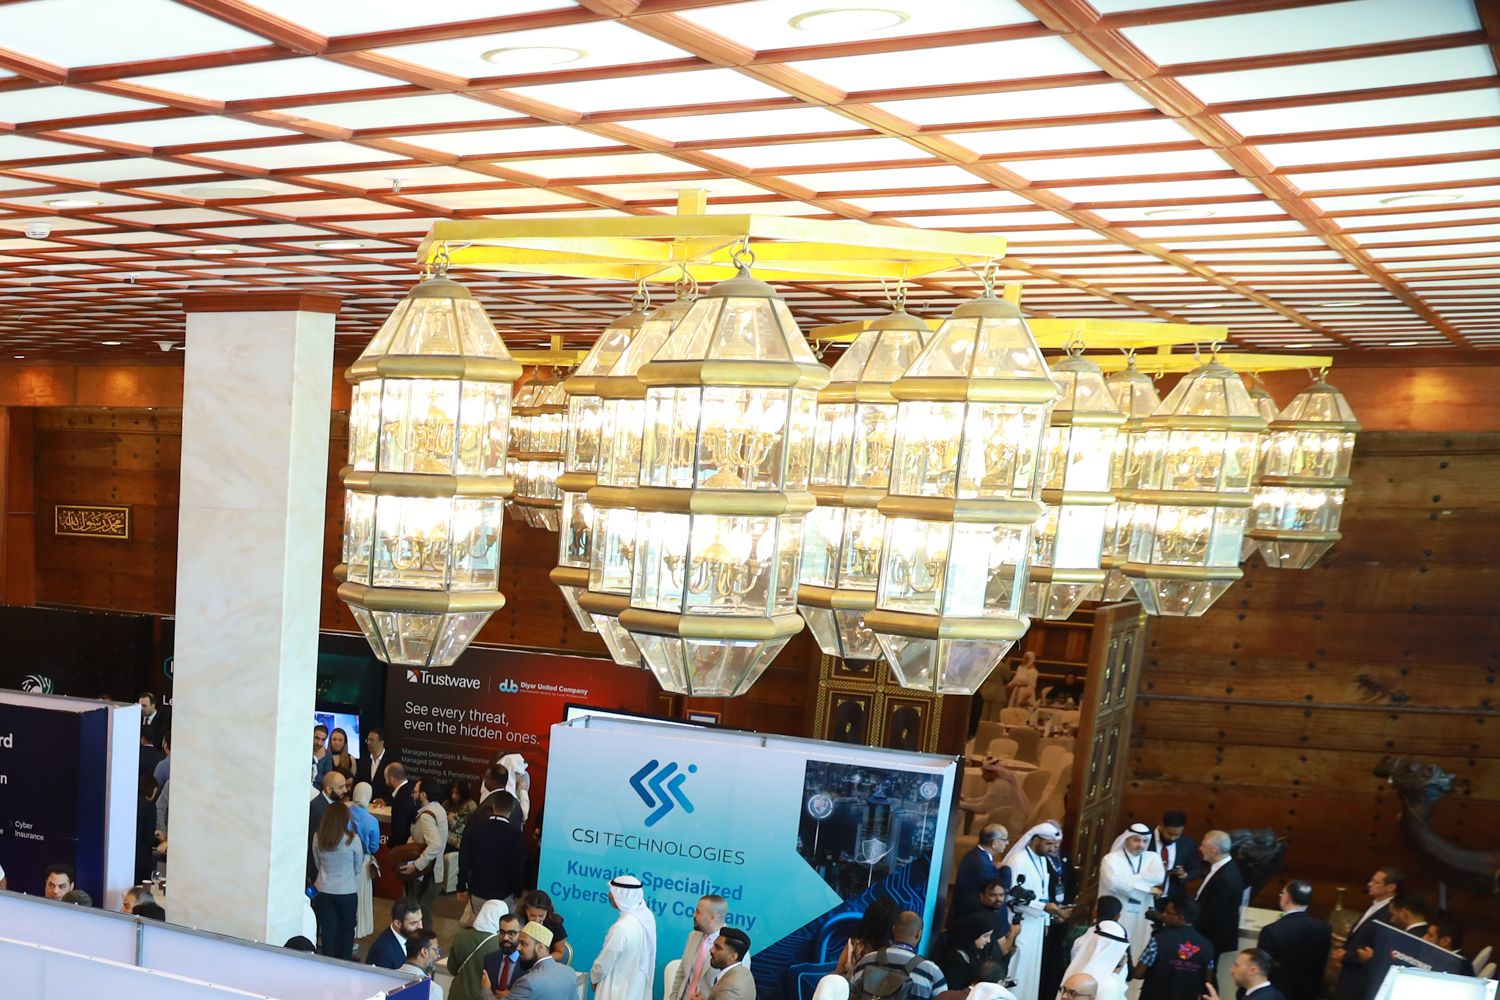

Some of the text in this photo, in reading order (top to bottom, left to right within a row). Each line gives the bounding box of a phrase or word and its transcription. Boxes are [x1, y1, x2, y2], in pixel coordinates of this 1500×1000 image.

[420, 670, 481, 690] Trustwave
[520, 682, 536, 690] Diyar
[538, 683, 557, 691] United
[559, 686, 588, 696] Company
[405, 701, 509, 728] See every threat,
[404, 719, 540, 745] even the hidden ones.
[401, 756, 427, 765] Managed
[402, 748, 427, 757] Managed
[429, 751, 455, 760] Detection
[462, 755, 490, 764] Response
[419, 766, 441, 776] Hunting
[448, 770, 480, 780] Penetration
[15, 820, 33, 830] Cyber
[15, 830, 45, 841] Insurance
[572, 828, 745, 865] CSI TECHNOLOGIES
[642, 872, 743, 901] Specialized
[672, 900, 757, 932] Coany
